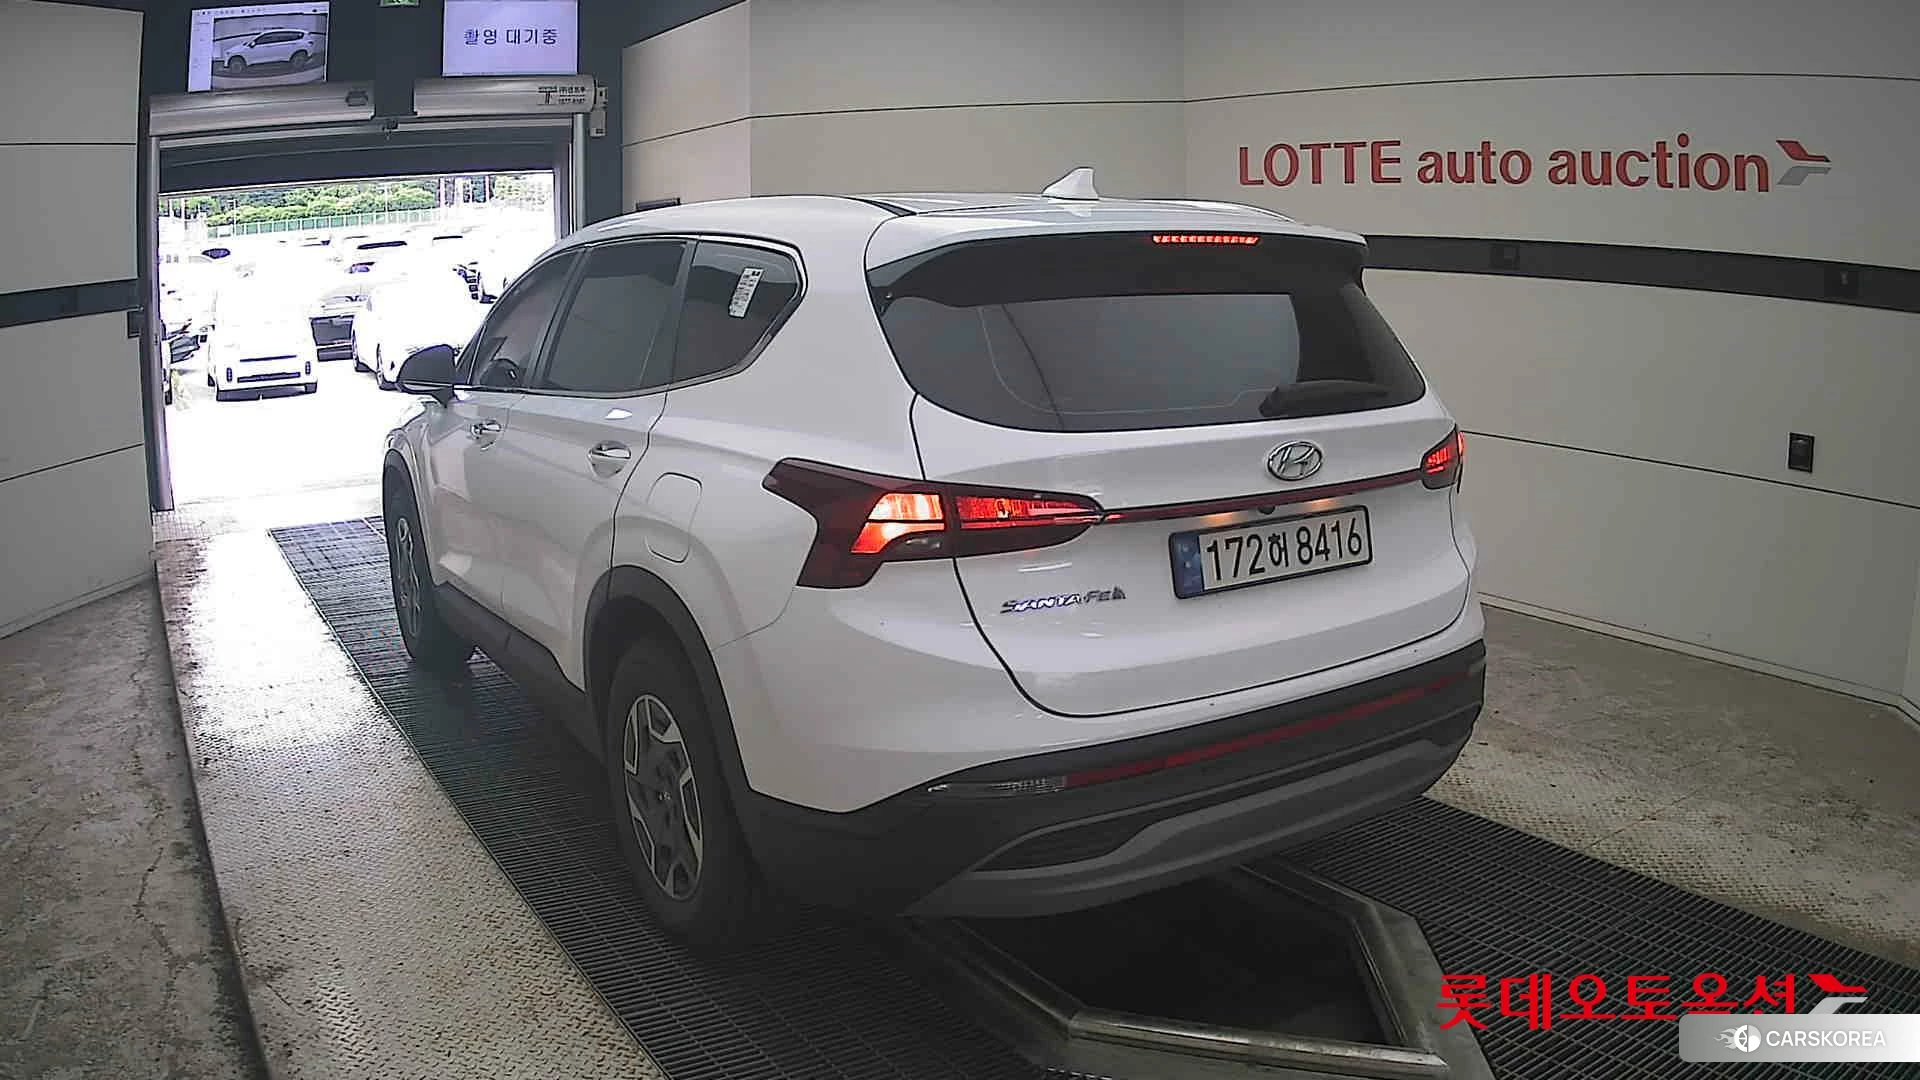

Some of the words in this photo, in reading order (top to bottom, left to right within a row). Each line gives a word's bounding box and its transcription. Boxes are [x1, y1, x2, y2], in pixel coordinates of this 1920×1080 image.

[505, 28, 558, 45] 대기중
[1239, 140, 1401, 187] LOTTE
[1417, 140, 1532, 185] auto
[1548, 133, 1770, 193] auction
[1206, 533, 1289, 581] 172허
[1296, 517, 1362, 566] 8416
[1000, 593, 1081, 614] SANTA
